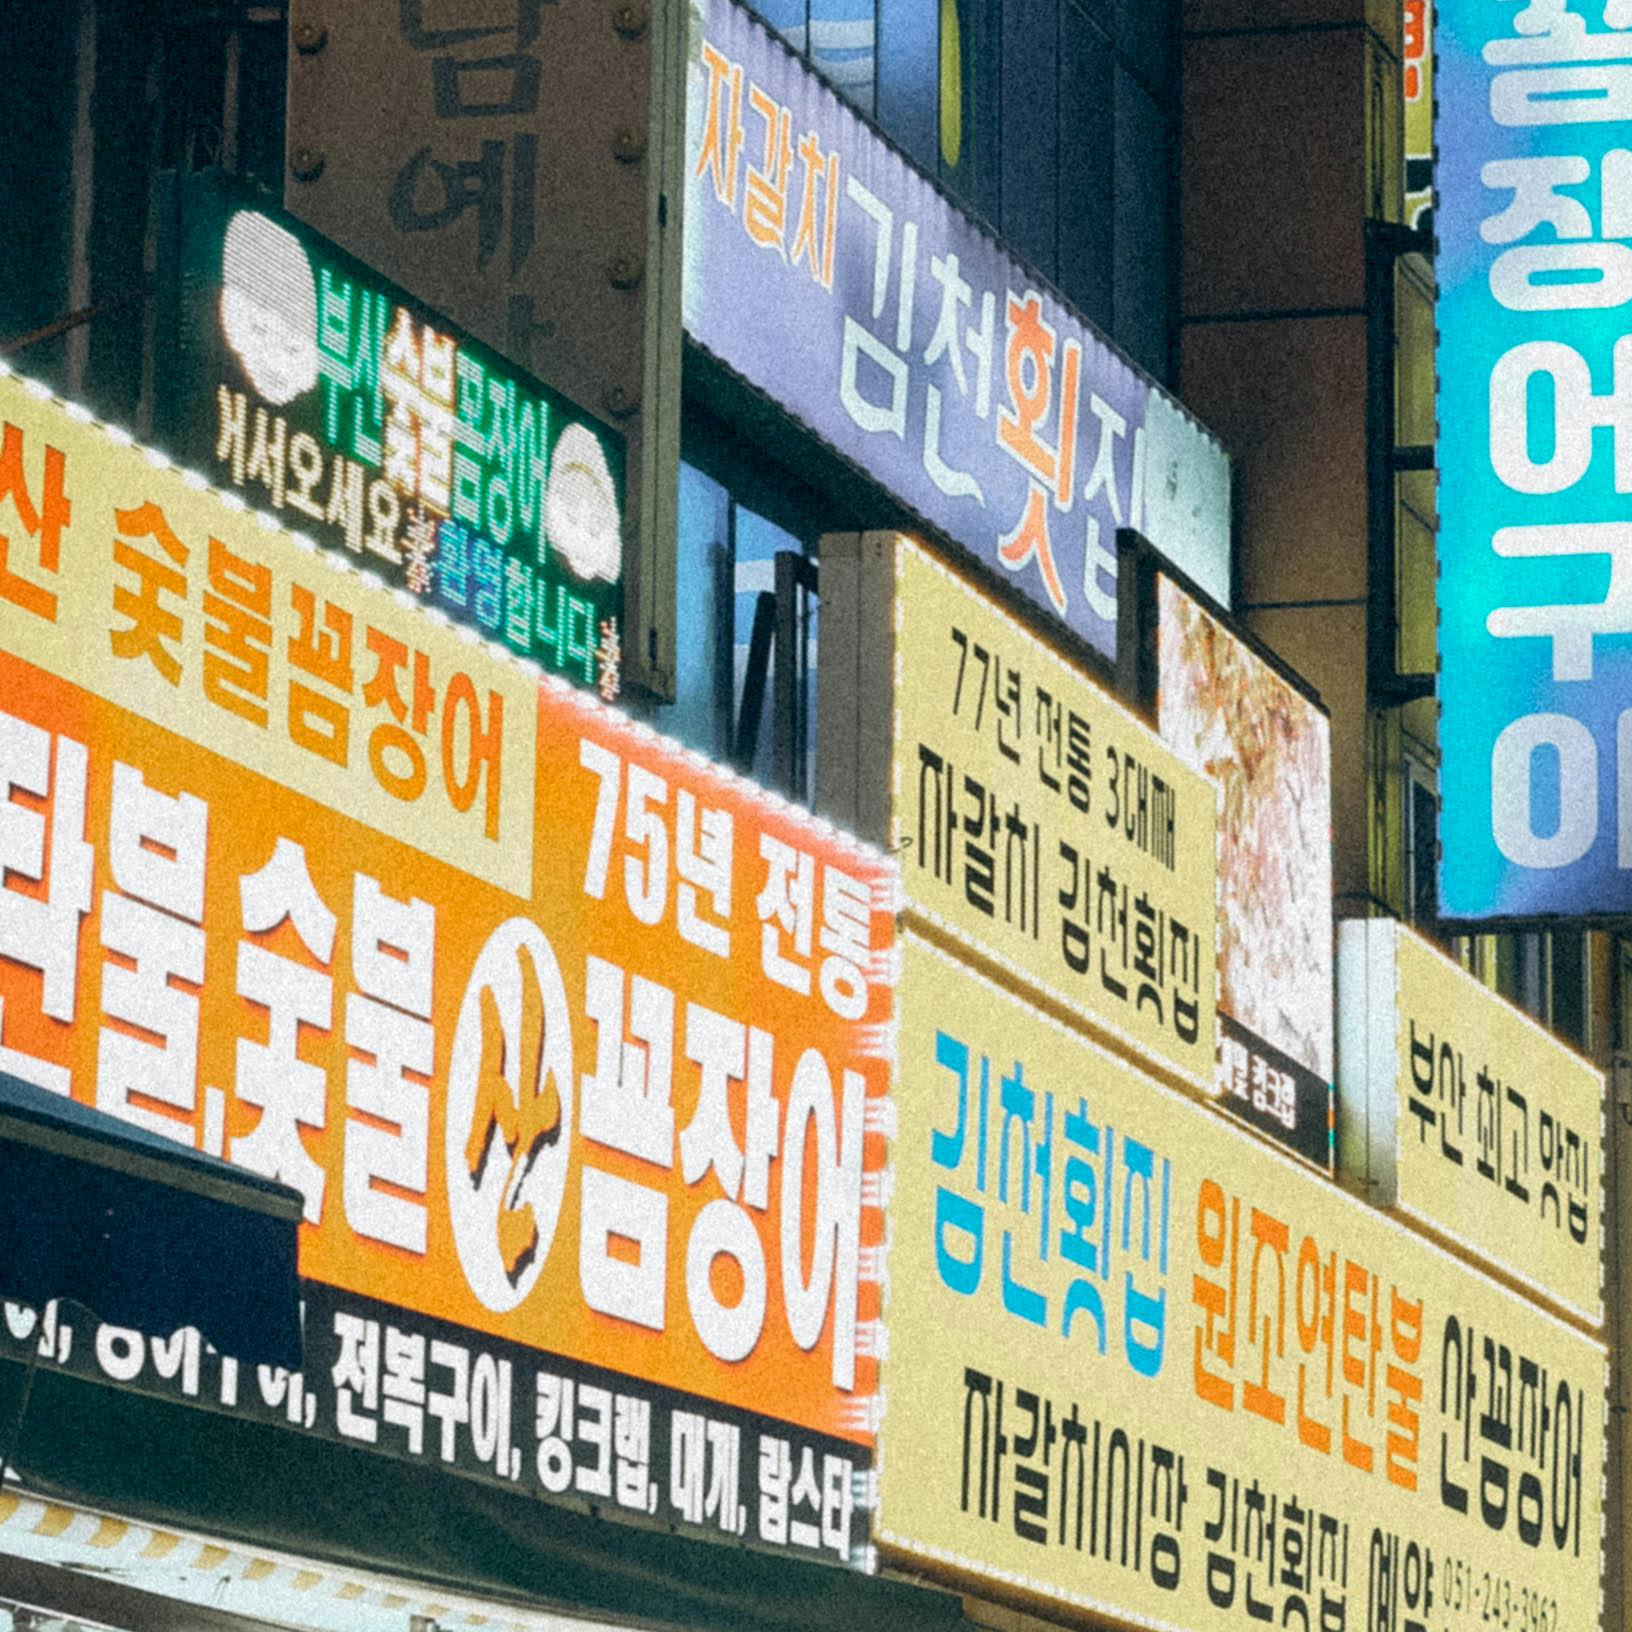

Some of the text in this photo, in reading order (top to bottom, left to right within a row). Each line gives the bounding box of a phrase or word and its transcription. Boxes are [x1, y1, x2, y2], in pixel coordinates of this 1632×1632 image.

[695, 42, 840, 296] 자갈치
[215, 383, 403, 567] 어서오세요
[840, 175, 1145, 623] 김천횟집
[951, 625, 1021, 766] 77년
[1036, 685, 1092, 815] 전통
[576, 738, 876, 1022] 75년 전통
[917, 741, 1201, 1046] 자갈치 김천횟집
[576, 954, 869, 1394] 꼼장어
[932, 1027, 1171, 1380] 김천횟집
[1410, 1018, 1465, 1168] 부산
[1475, 1063, 1530, 1205] 최고
[1539, 1110, 1590, 1246] 맛집
[757, 1434, 855, 1563] 랍스타
[960, 1364, 1189, 1592] 자갈치시장
